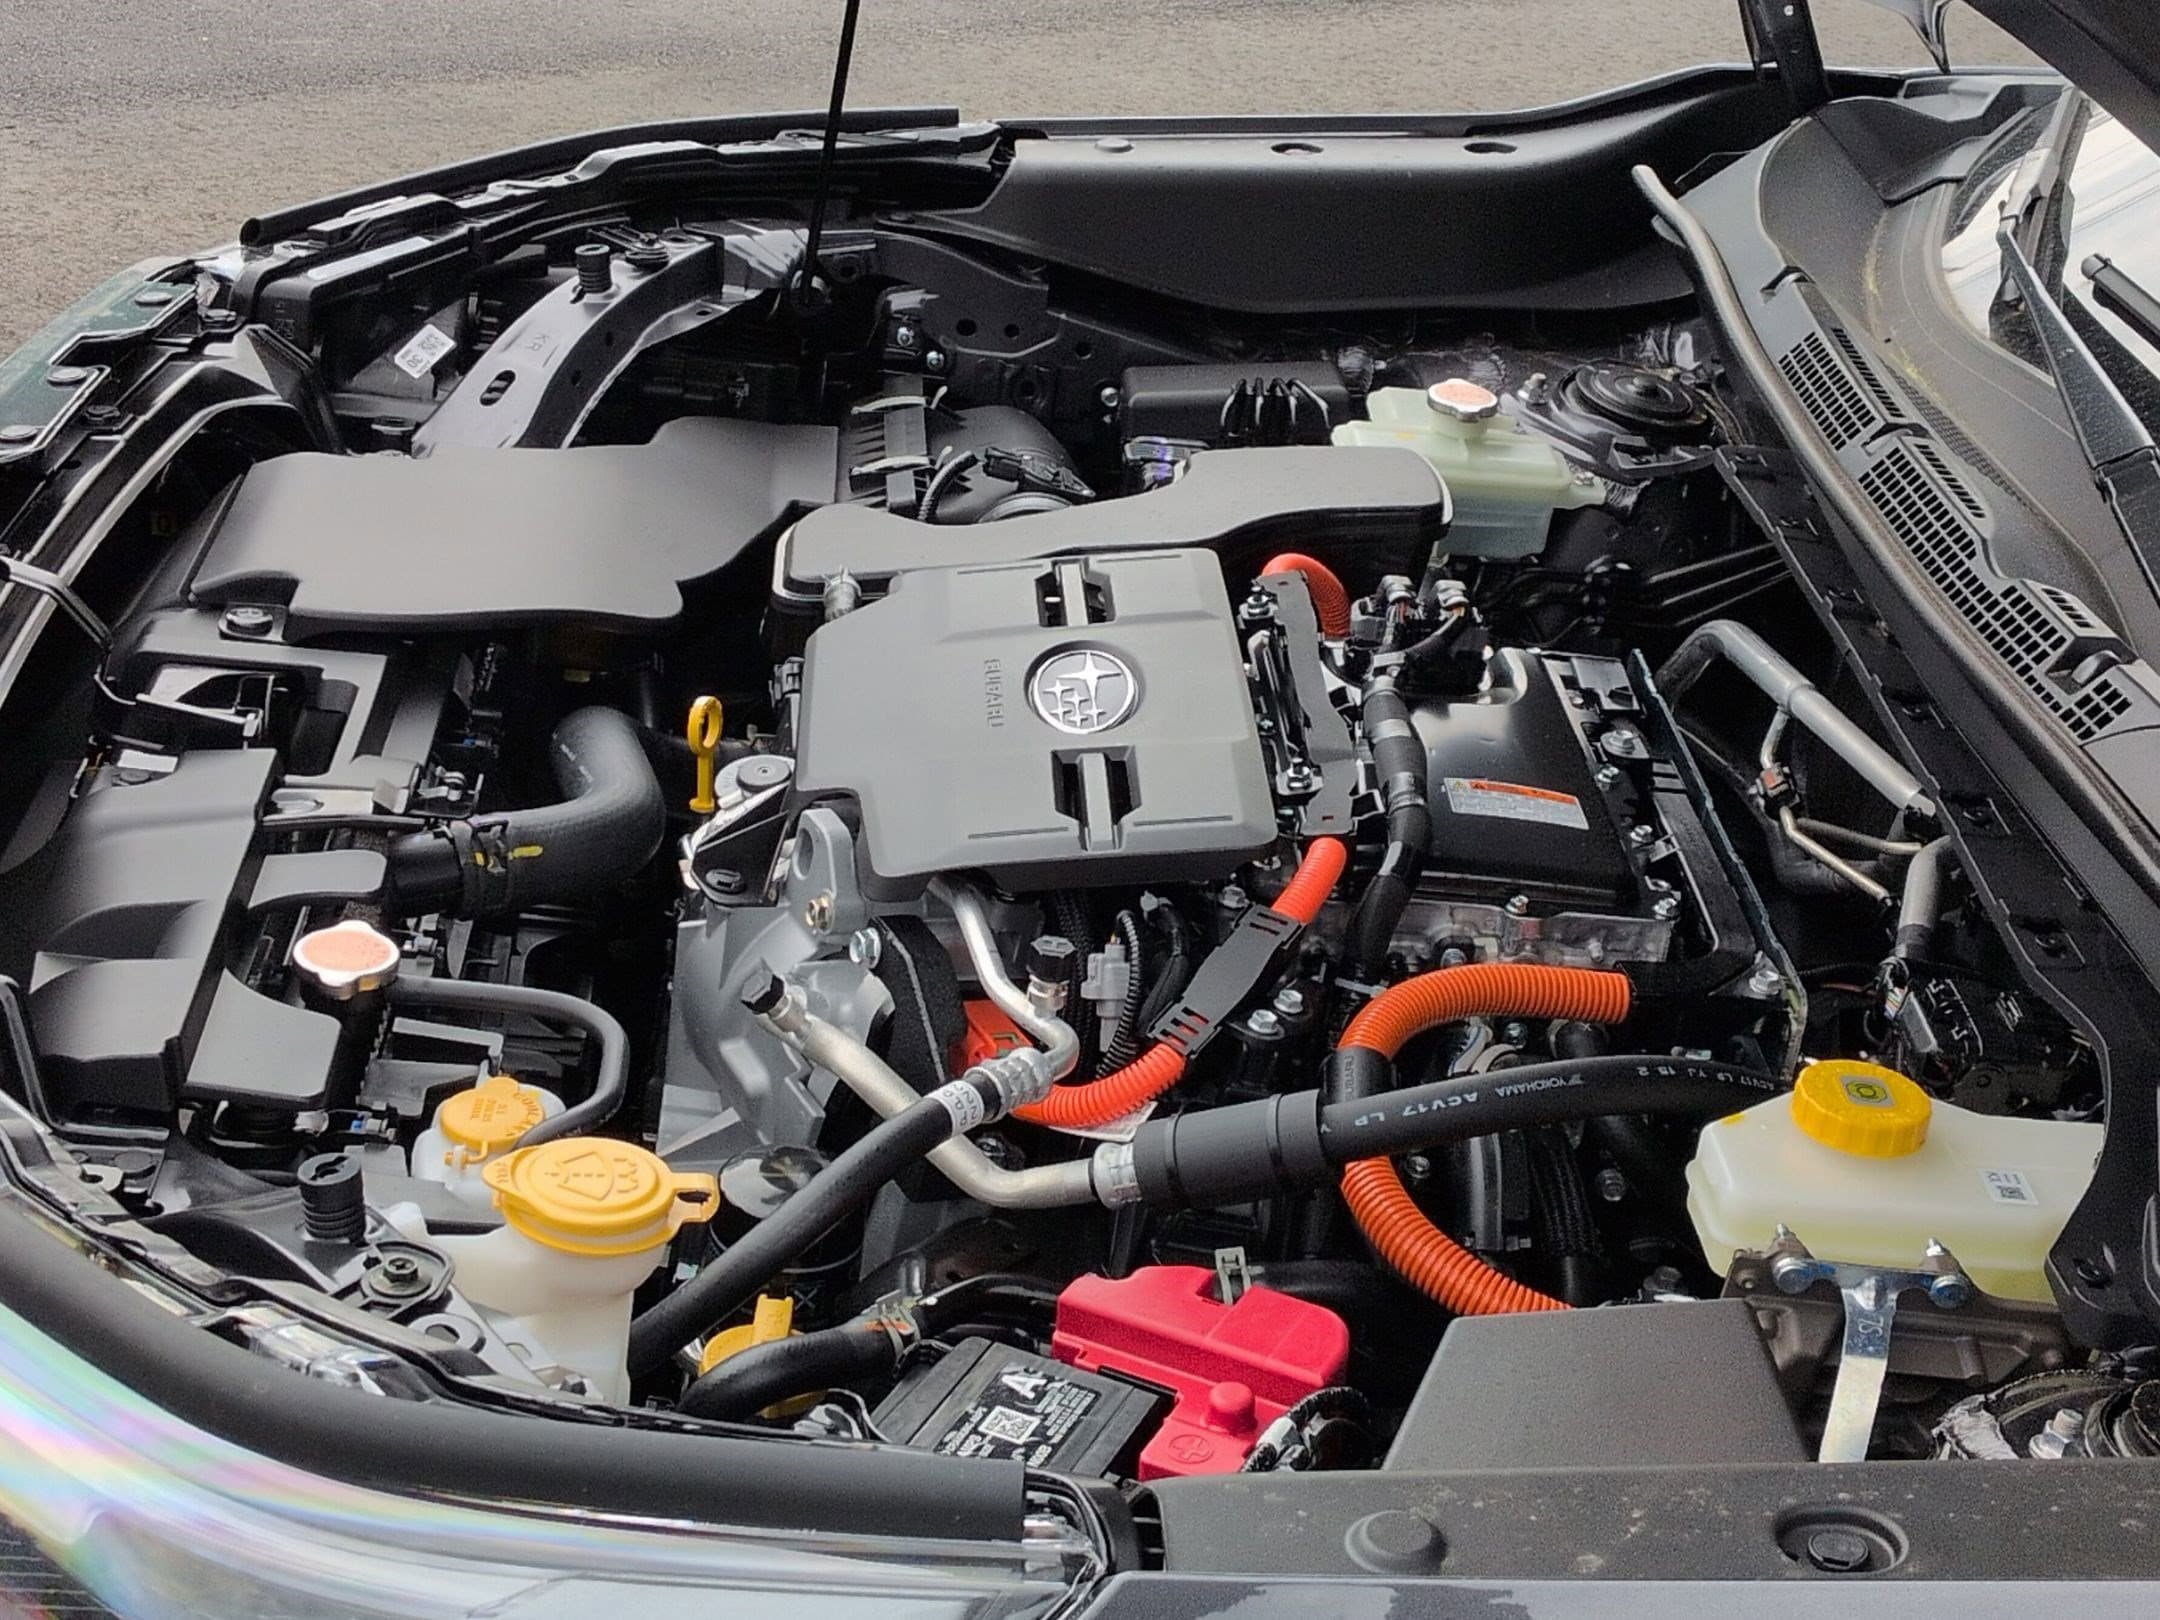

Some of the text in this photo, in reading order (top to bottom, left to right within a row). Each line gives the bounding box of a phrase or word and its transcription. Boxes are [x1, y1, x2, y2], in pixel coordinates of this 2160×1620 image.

[983, 658, 1004, 728] SUBARU
[1494, 1075, 1567, 1097] YOKOHAMA
[1402, 1091, 1479, 1117] ACV17
[1354, 1111, 1385, 1127] LP
